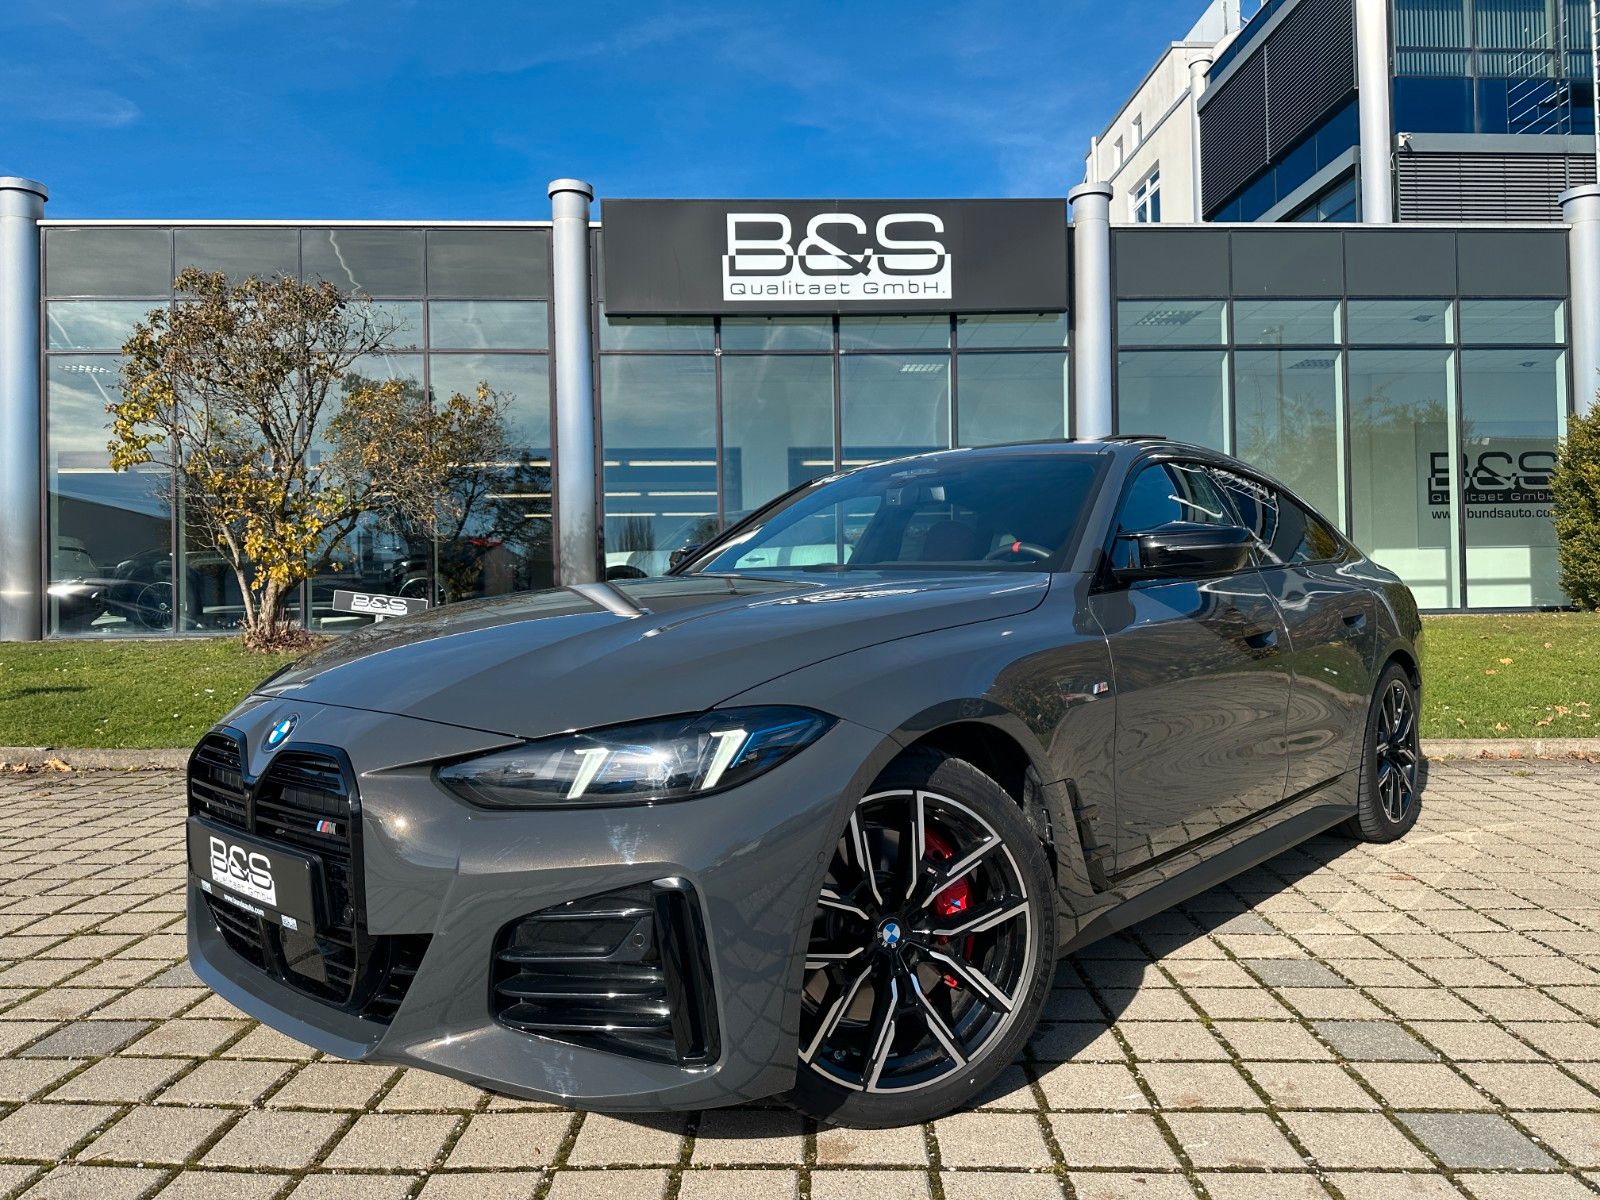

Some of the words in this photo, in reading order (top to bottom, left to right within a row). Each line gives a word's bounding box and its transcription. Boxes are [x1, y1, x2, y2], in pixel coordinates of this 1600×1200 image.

[726, 212, 946, 277] B&S
[729, 280, 850, 296] Qualitaet
[862, 280, 946, 295] GmbH.
[1430, 451, 1557, 491] B&S
[1431, 491, 1505, 503] Quitaet
[352, 593, 407, 611] B&S
[209, 835, 273, 891] B&S
